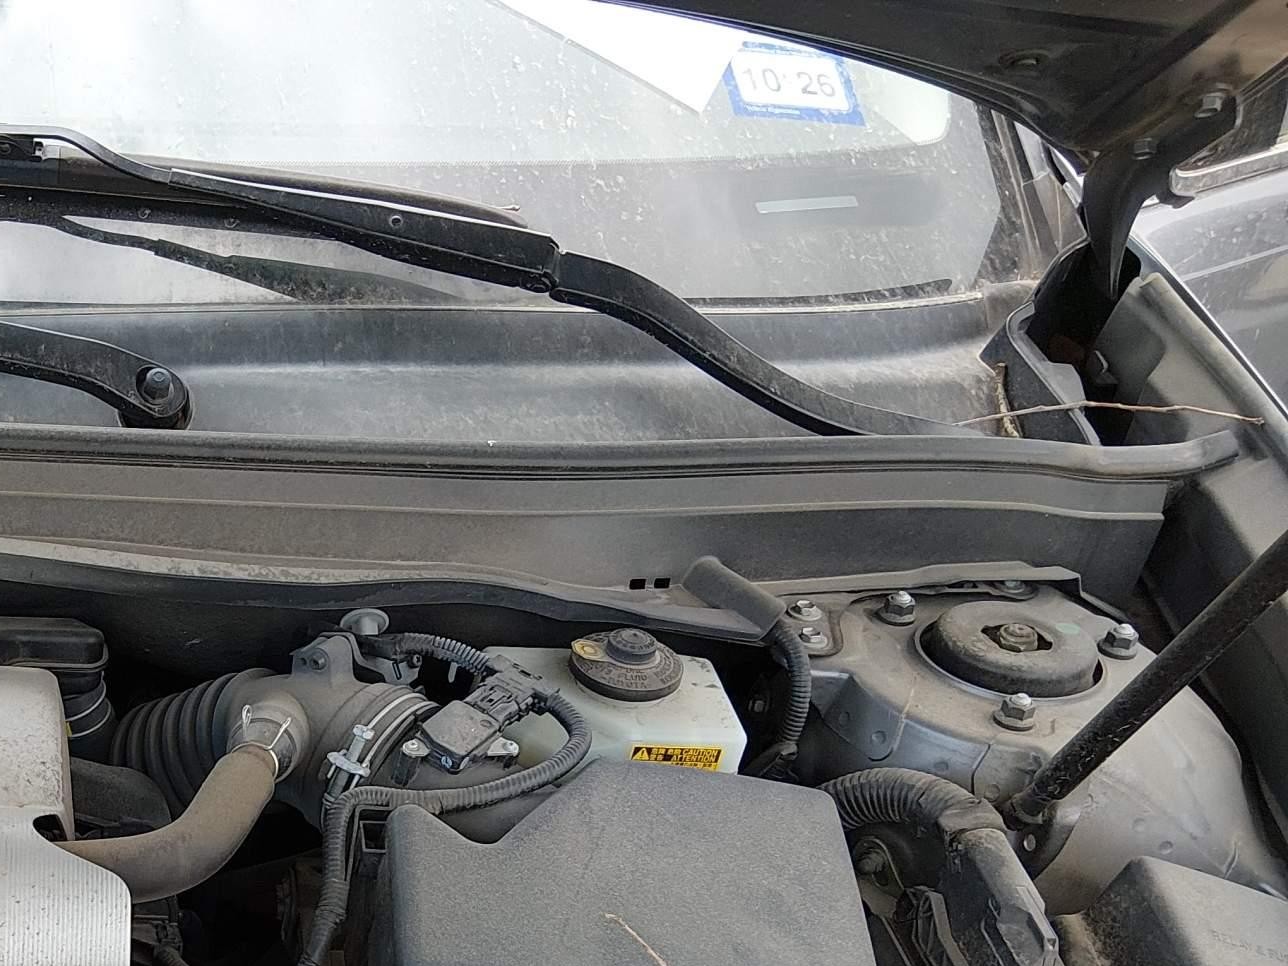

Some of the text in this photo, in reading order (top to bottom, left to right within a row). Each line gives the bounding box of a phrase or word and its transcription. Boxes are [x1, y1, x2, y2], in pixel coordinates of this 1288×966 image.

[796, 71, 837, 97] 26
[682, 748, 718, 756] CAUTION
[670, 754, 716, 762] ATTENTION
